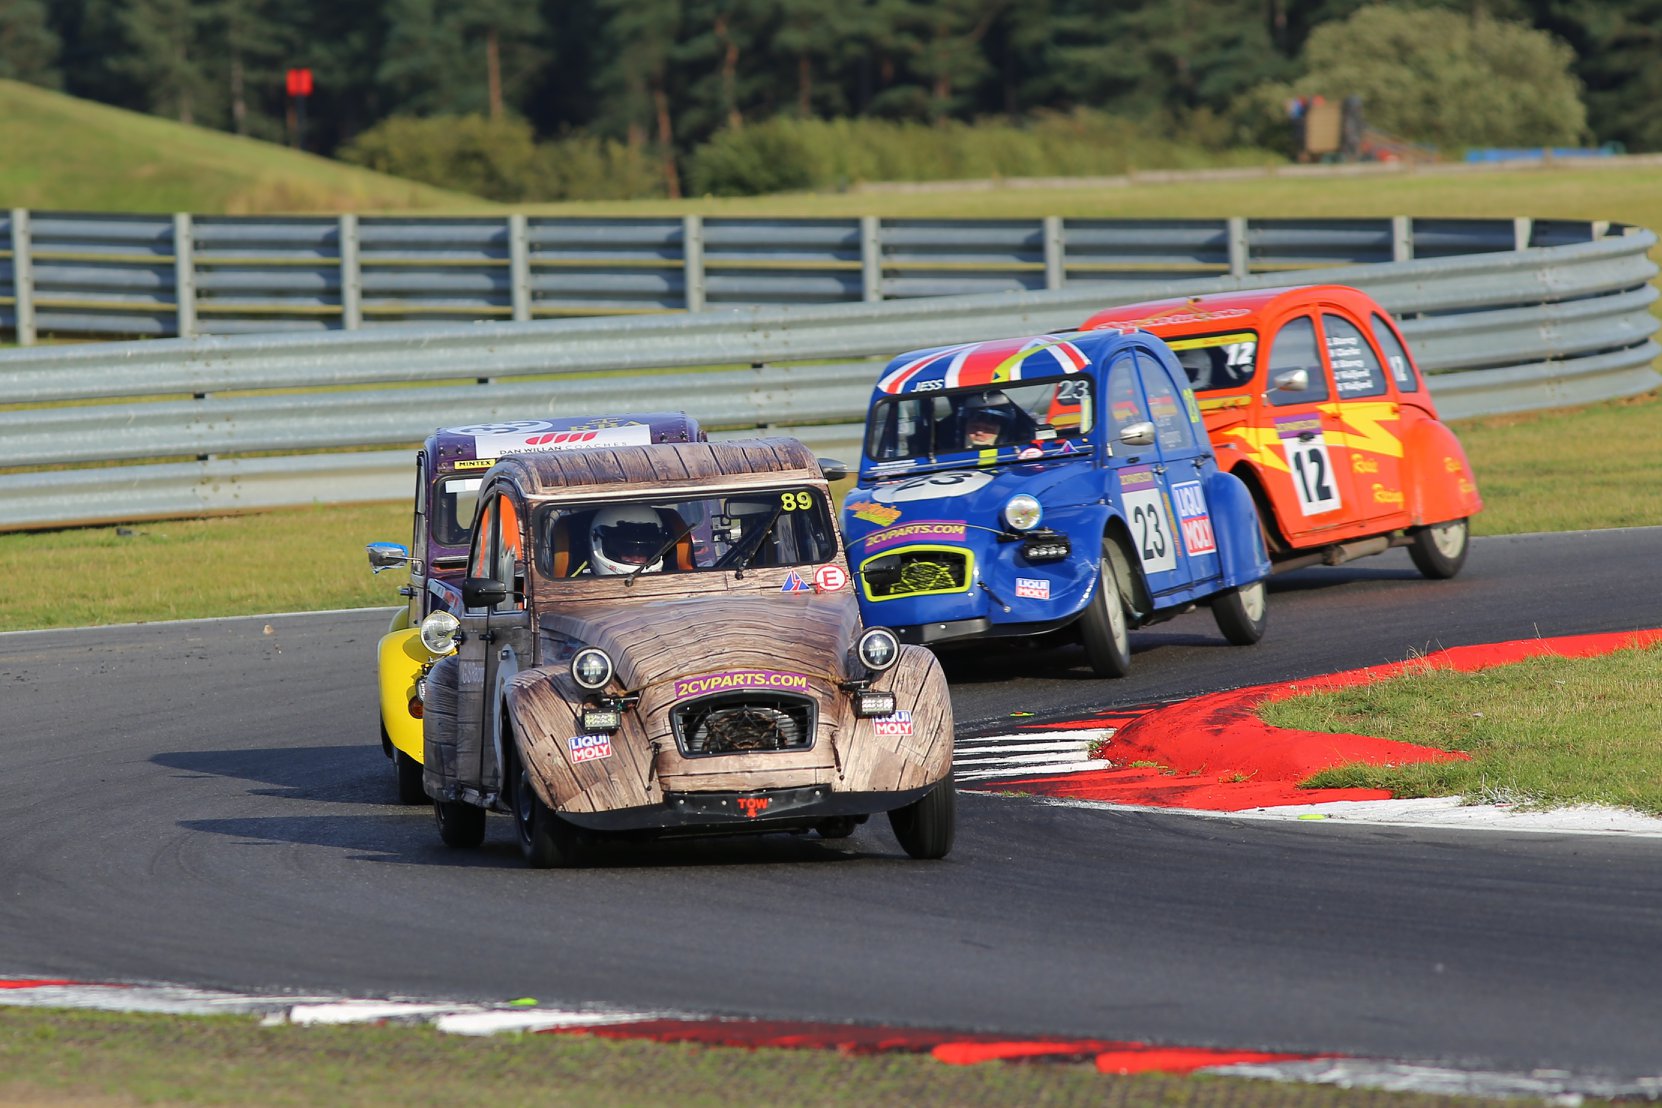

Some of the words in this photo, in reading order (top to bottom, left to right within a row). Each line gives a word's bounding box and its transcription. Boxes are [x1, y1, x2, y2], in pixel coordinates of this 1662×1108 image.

[1227, 342, 1256, 366] 12
[910, 379, 945, 393] JESS
[1057, 380, 1089, 400] 23
[524, 446, 562, 454] WILLAN
[565, 441, 628, 450] COACHES
[892, 472, 972, 494] 23
[1294, 448, 1332, 503] 12
[781, 491, 813, 511] 89
[1175, 486, 1206, 516] LIQUI
[866, 524, 965, 546] 2CVPARTS.COM
[1134, 503, 1165, 560] 23
[1185, 521, 1213, 549] MOLY
[822, 570, 839, 586] E
[1018, 580, 1048, 588] LIQUI
[1017, 589, 1048, 598] MOLY
[678, 673, 807, 697] 2CVPARTS.COM
[876, 721, 914, 735] MOLY
[569, 734, 607, 750] LIQUI
[573, 746, 611, 762] MOLY
[738, 798, 768, 811] TOW
